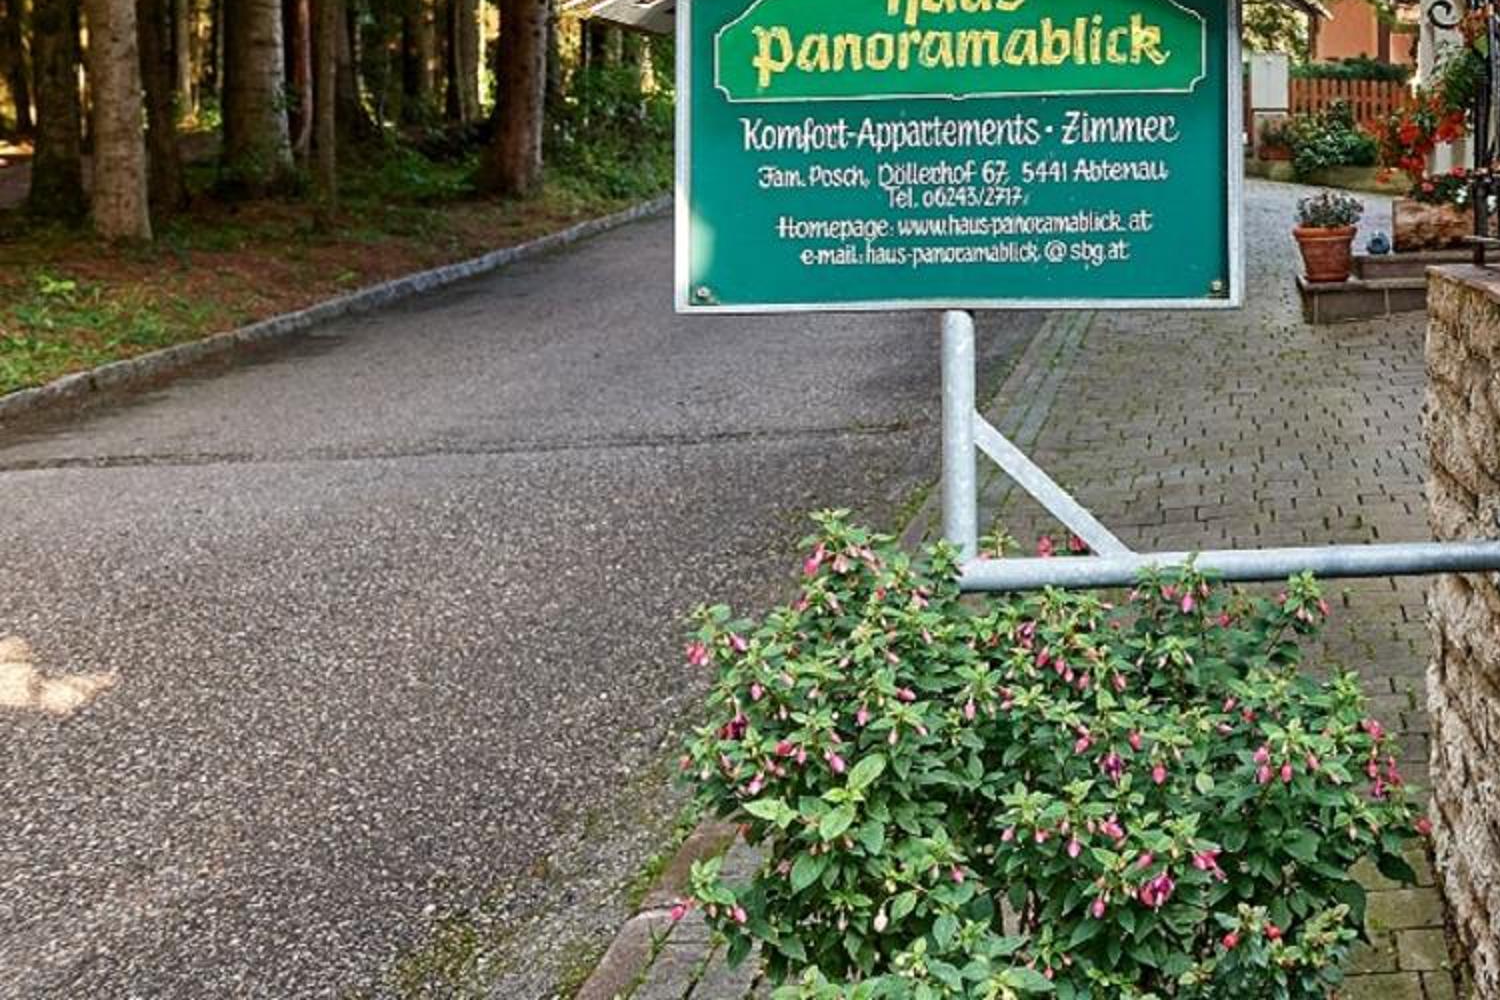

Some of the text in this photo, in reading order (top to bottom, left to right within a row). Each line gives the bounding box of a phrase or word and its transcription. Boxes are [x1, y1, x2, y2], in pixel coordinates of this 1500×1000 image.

[753, 14, 1171, 88] Panoramablick
[738, 111, 1180, 153] Komfort-Appartements Zimmer
[757, 165, 806, 188] Fam.
[878, 160, 977, 189] Döllerhof
[1022, 160, 1067, 183] 5441
[1073, 158, 1169, 181] Abtenau
[886, 186, 919, 208] Tel.
[776, 215, 894, 241] Homepage:
